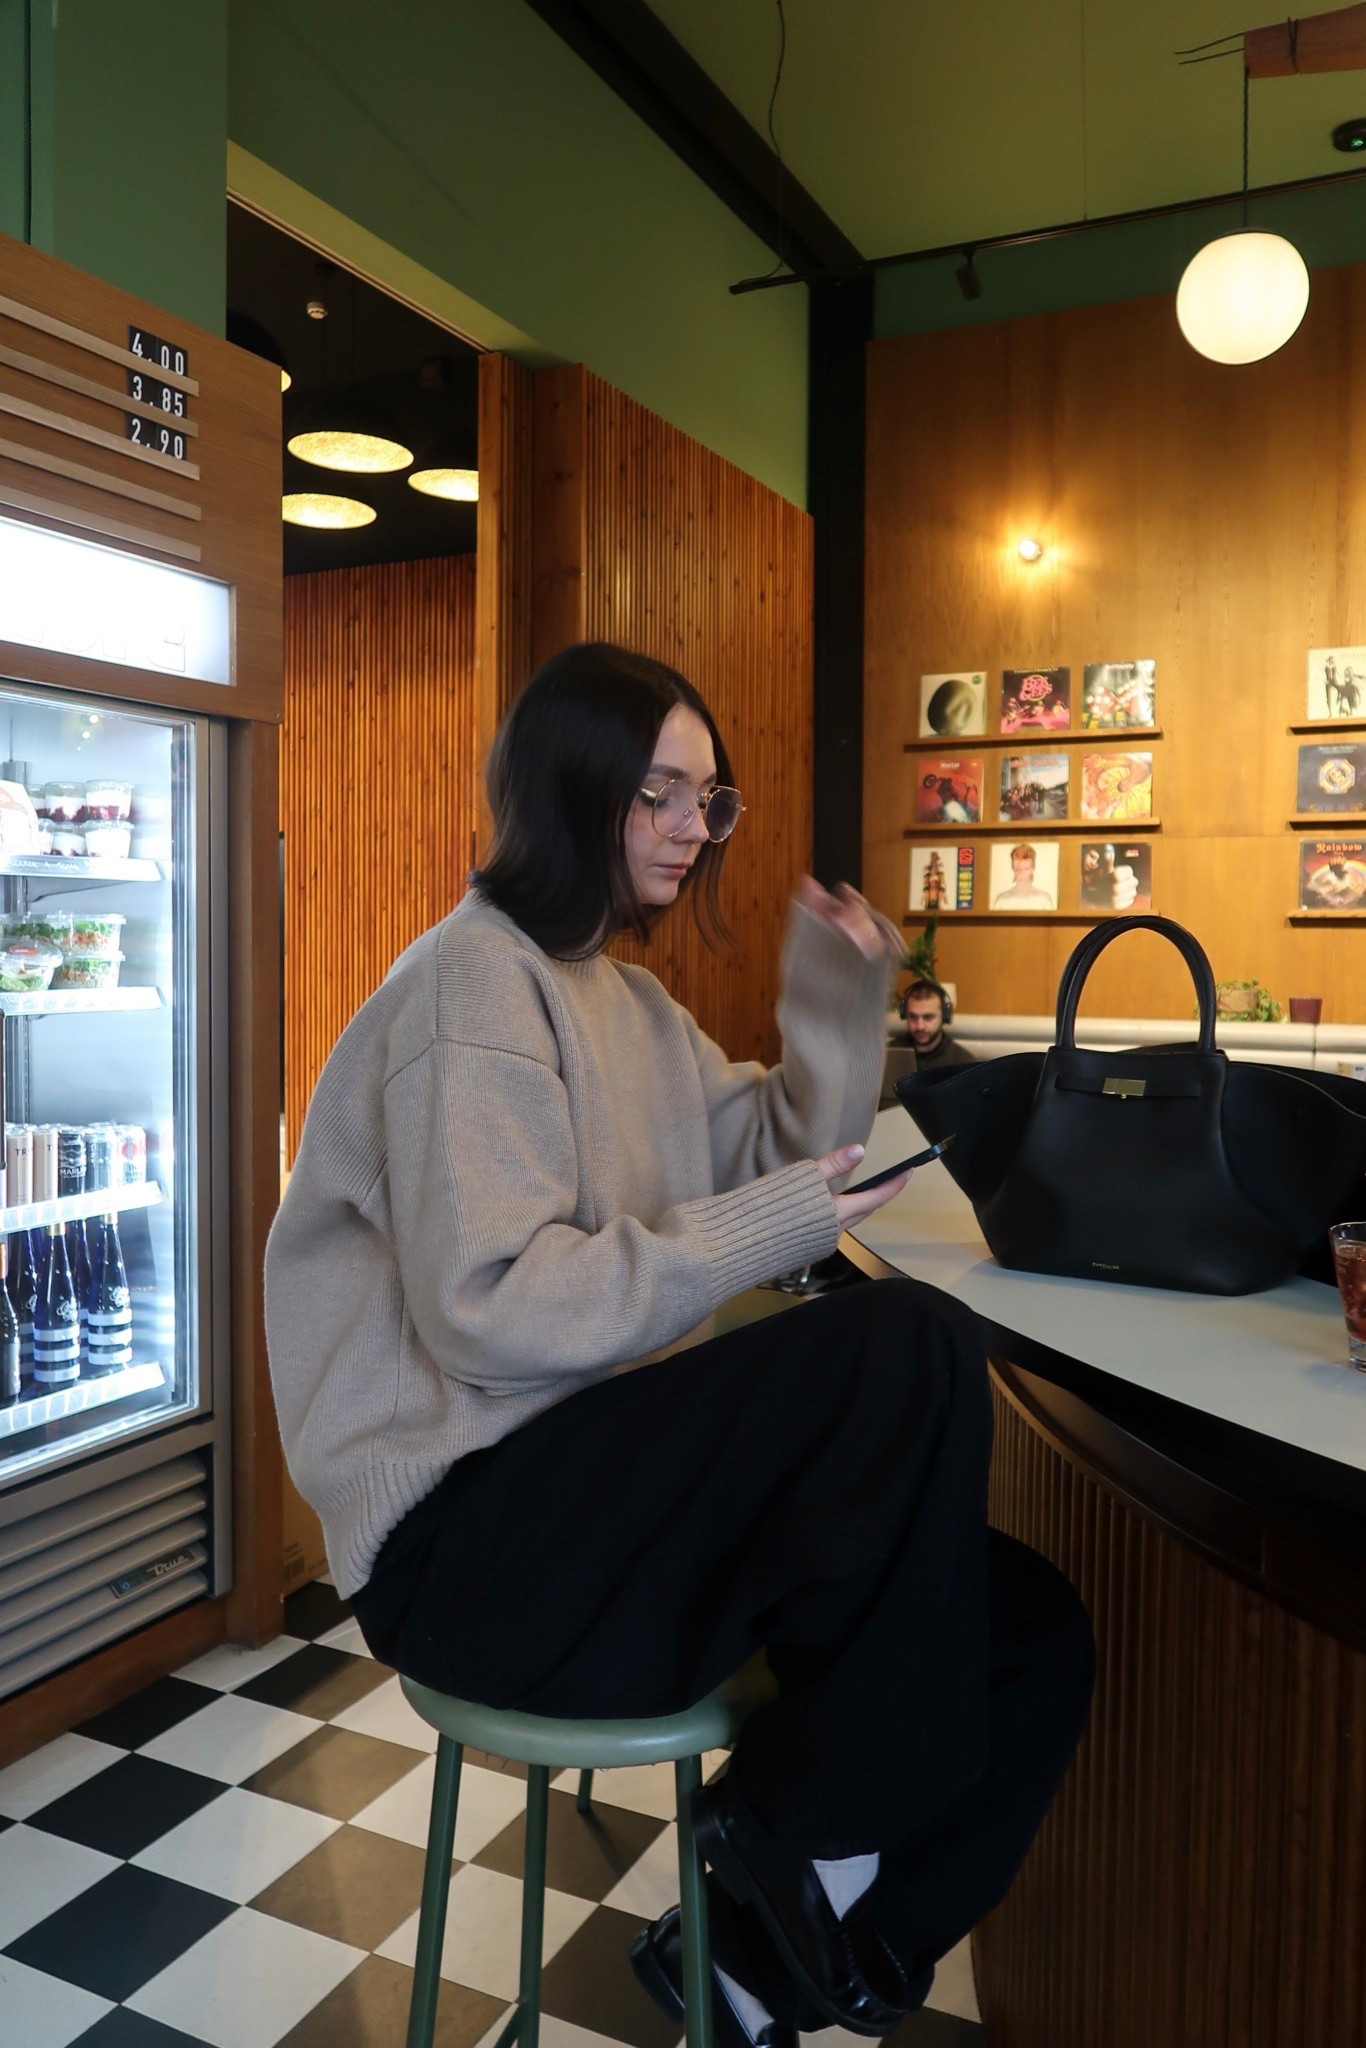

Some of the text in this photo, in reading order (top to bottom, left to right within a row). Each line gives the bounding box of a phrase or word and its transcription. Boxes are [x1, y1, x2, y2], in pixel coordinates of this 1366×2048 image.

[132, 332, 184, 376] 4.00
[132, 375, 184, 417] 3.85
[131, 418, 183, 460] 2.90
[1316, 842, 1363, 853] Rainbow
[146, 1555, 189, 1576] True
